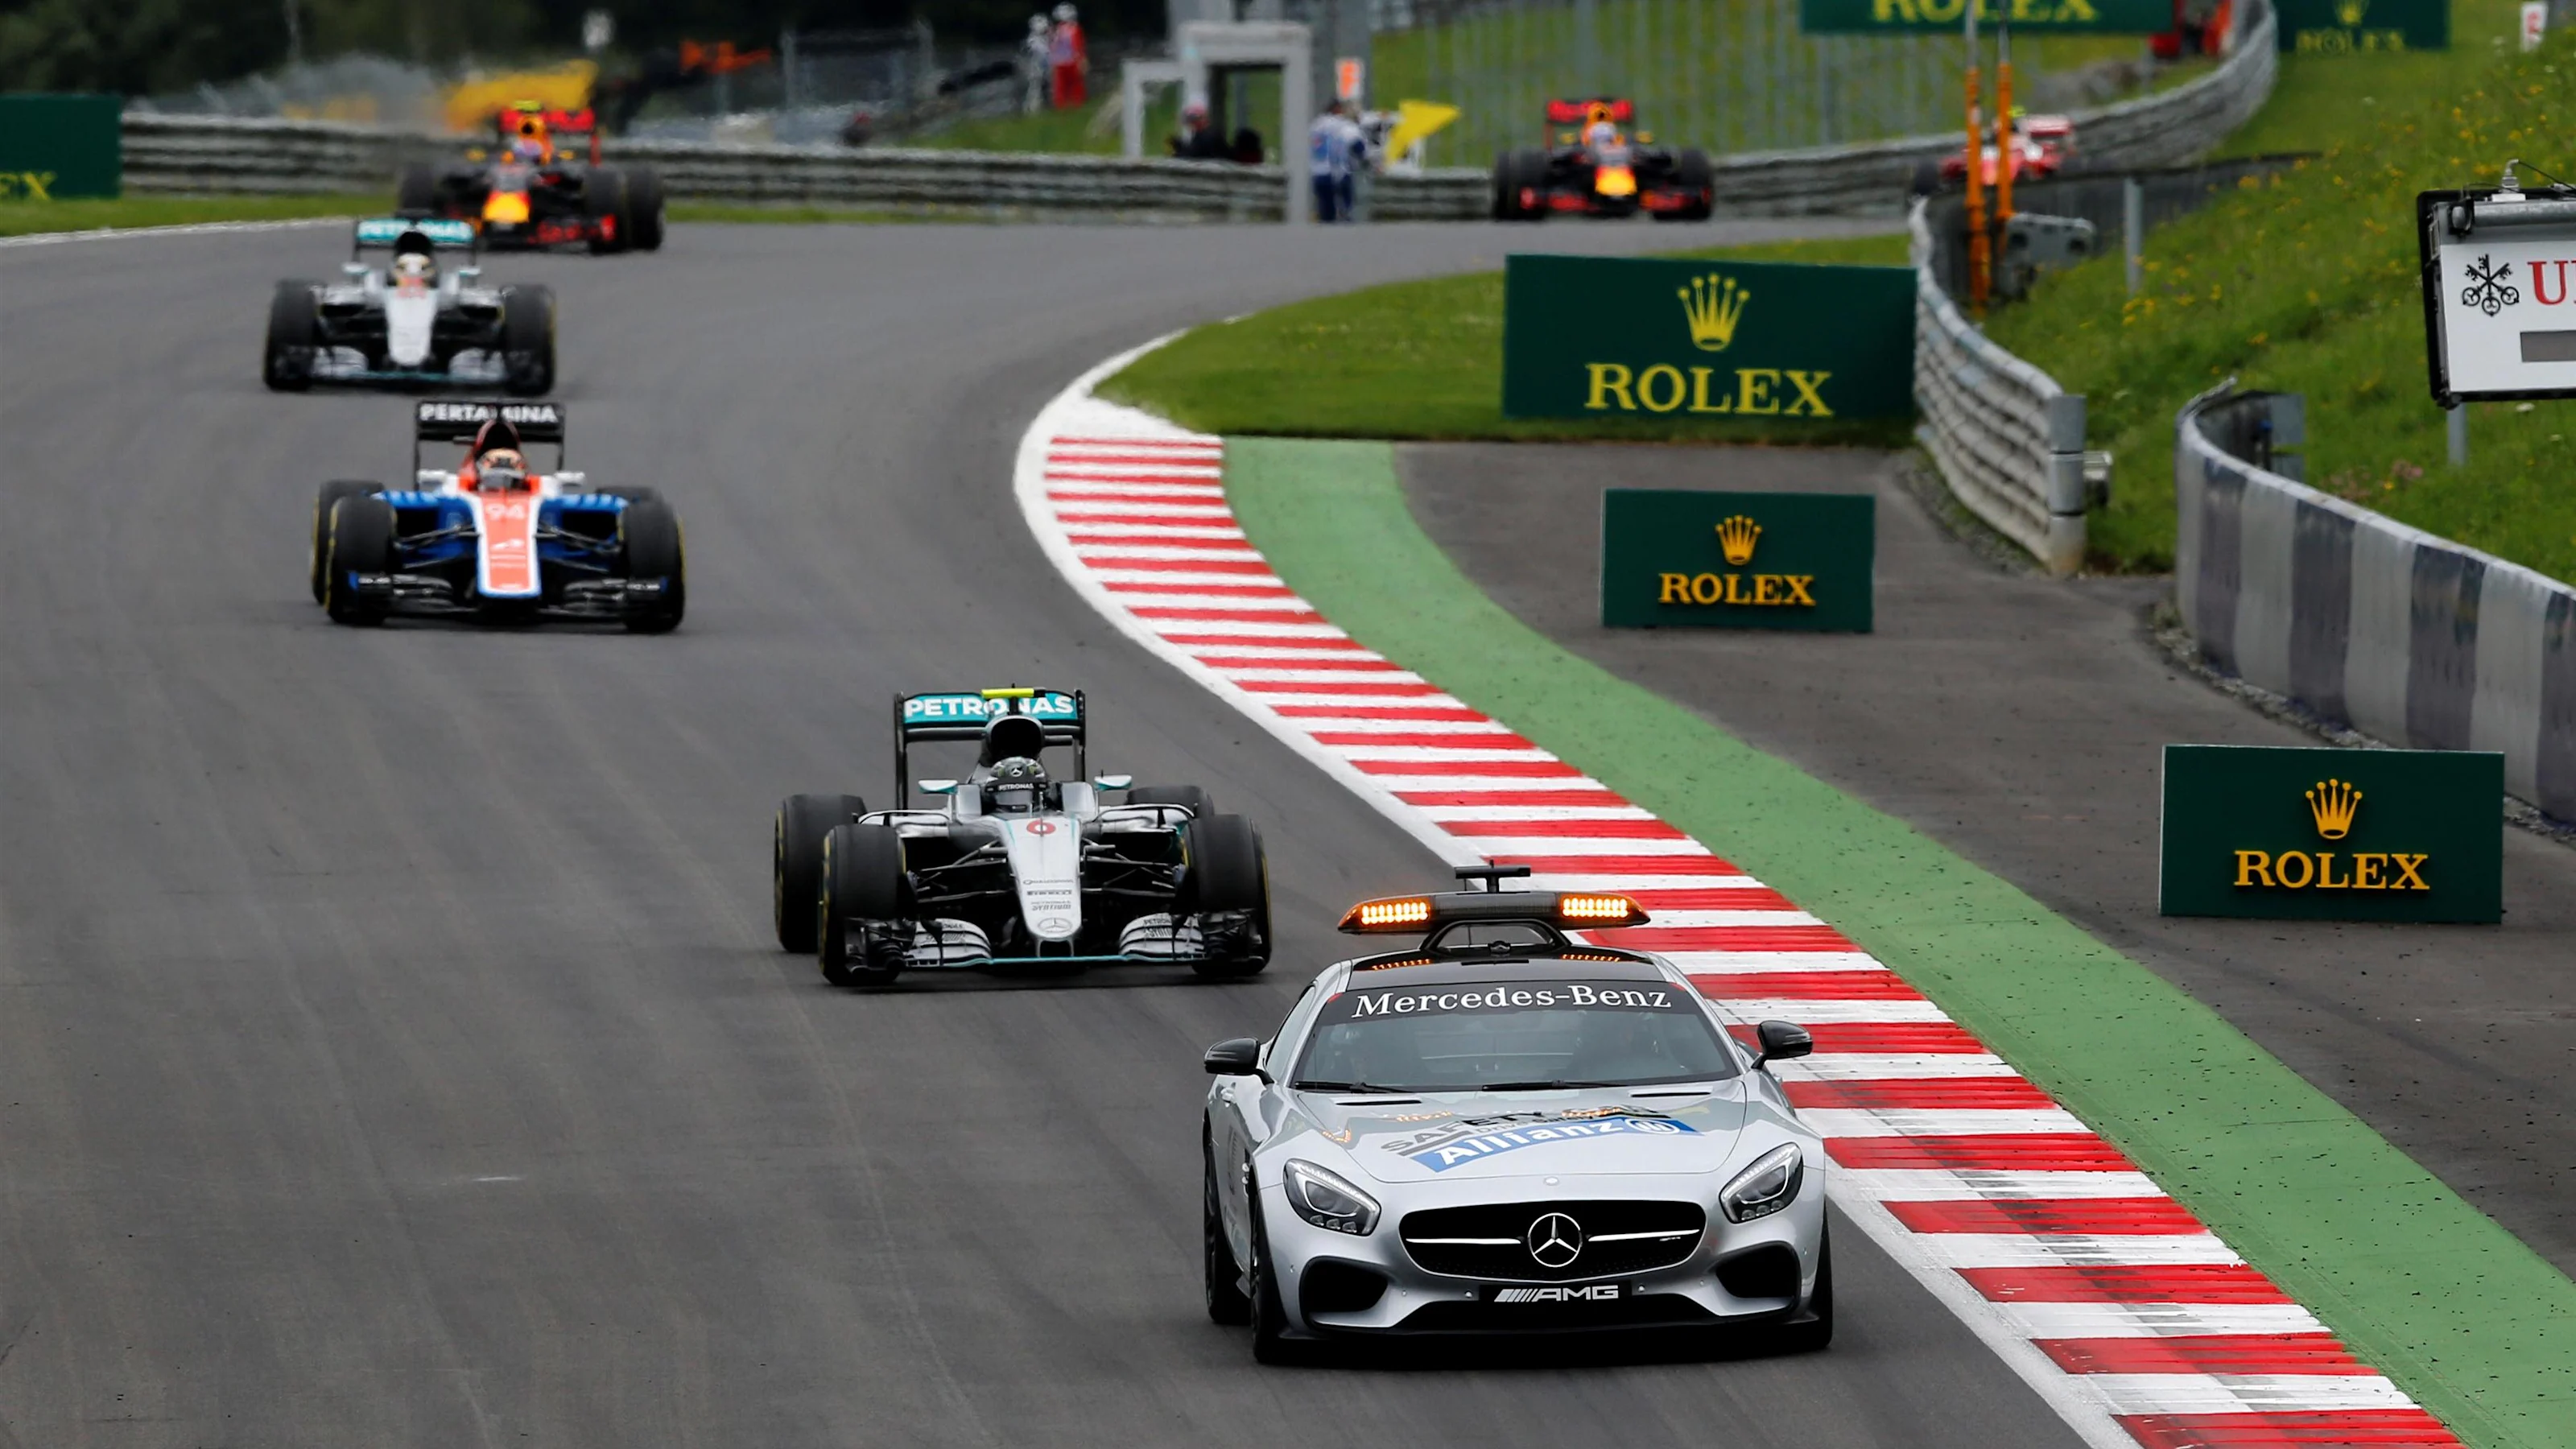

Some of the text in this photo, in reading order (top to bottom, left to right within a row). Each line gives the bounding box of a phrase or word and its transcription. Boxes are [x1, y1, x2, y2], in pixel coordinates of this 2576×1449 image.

[2527, 260, 2576, 306] U
[1583, 363, 1834, 418] ROLEX
[485, 504, 526, 521] 94
[1658, 572, 1816, 606] ROLEX
[998, 782, 1034, 791] PETRONAS
[2234, 850, 2430, 890] ROLEX
[1351, 985, 1672, 1018] Mercedes-Benz
[1434, 1121, 1624, 1166] Allianz
[1530, 1285, 1619, 1302] AMG
